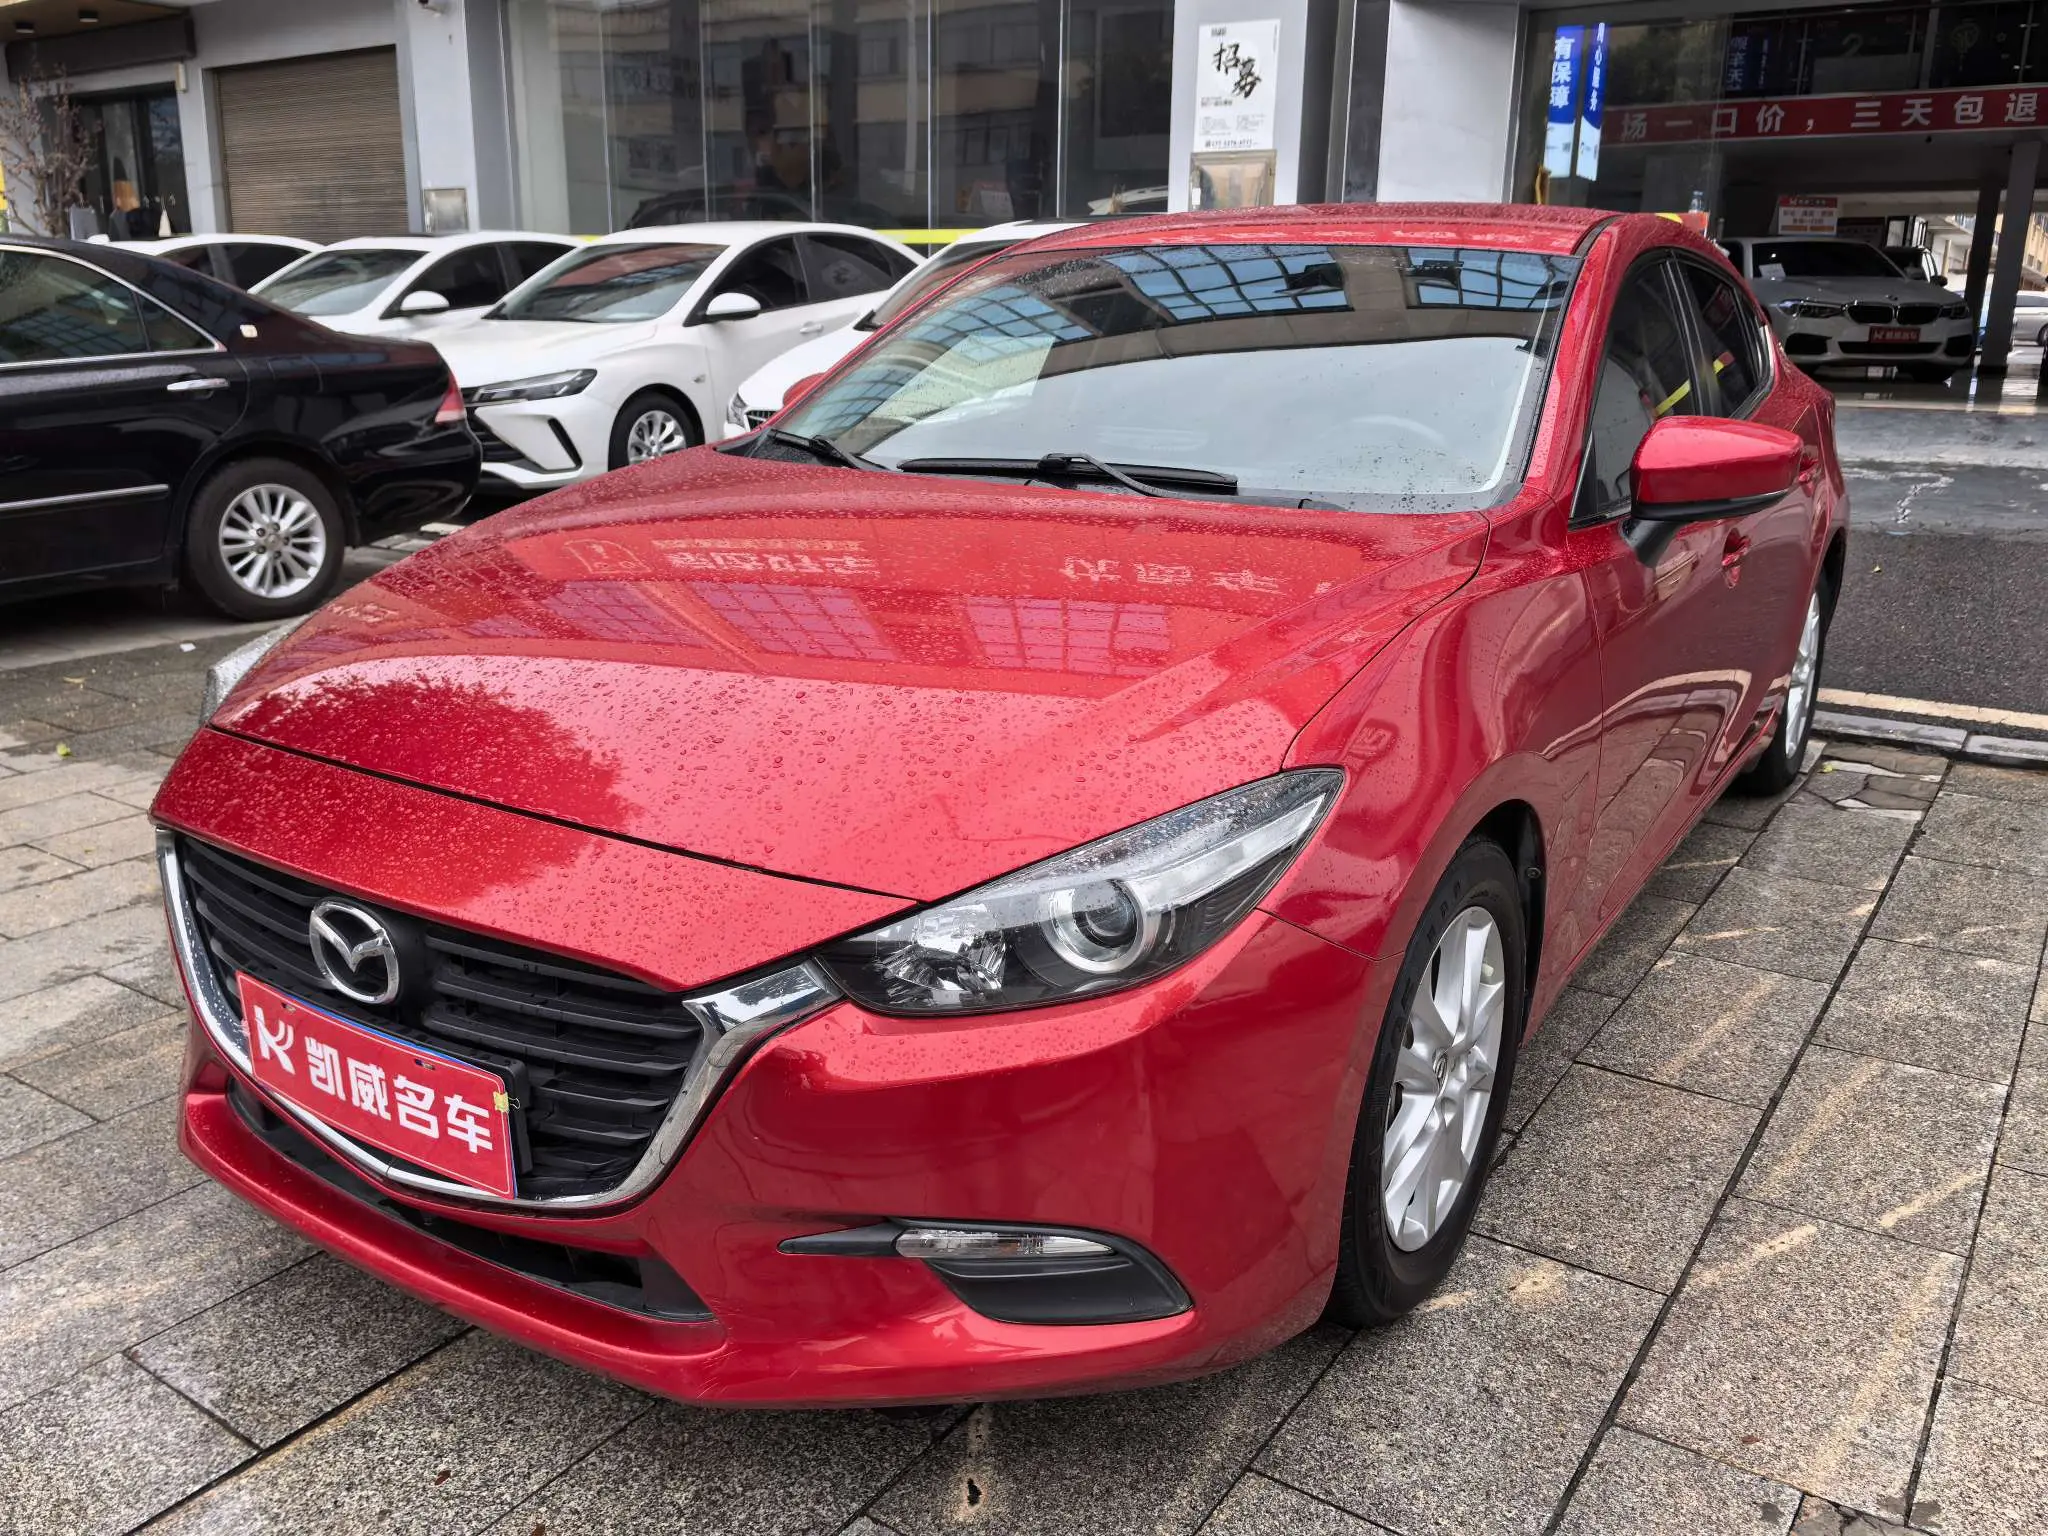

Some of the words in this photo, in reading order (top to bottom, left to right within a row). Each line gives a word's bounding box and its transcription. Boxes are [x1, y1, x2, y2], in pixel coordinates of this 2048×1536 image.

[1549, 36, 1575, 109] 有保障
[304, 1035, 493, 1154] 凯威名车
